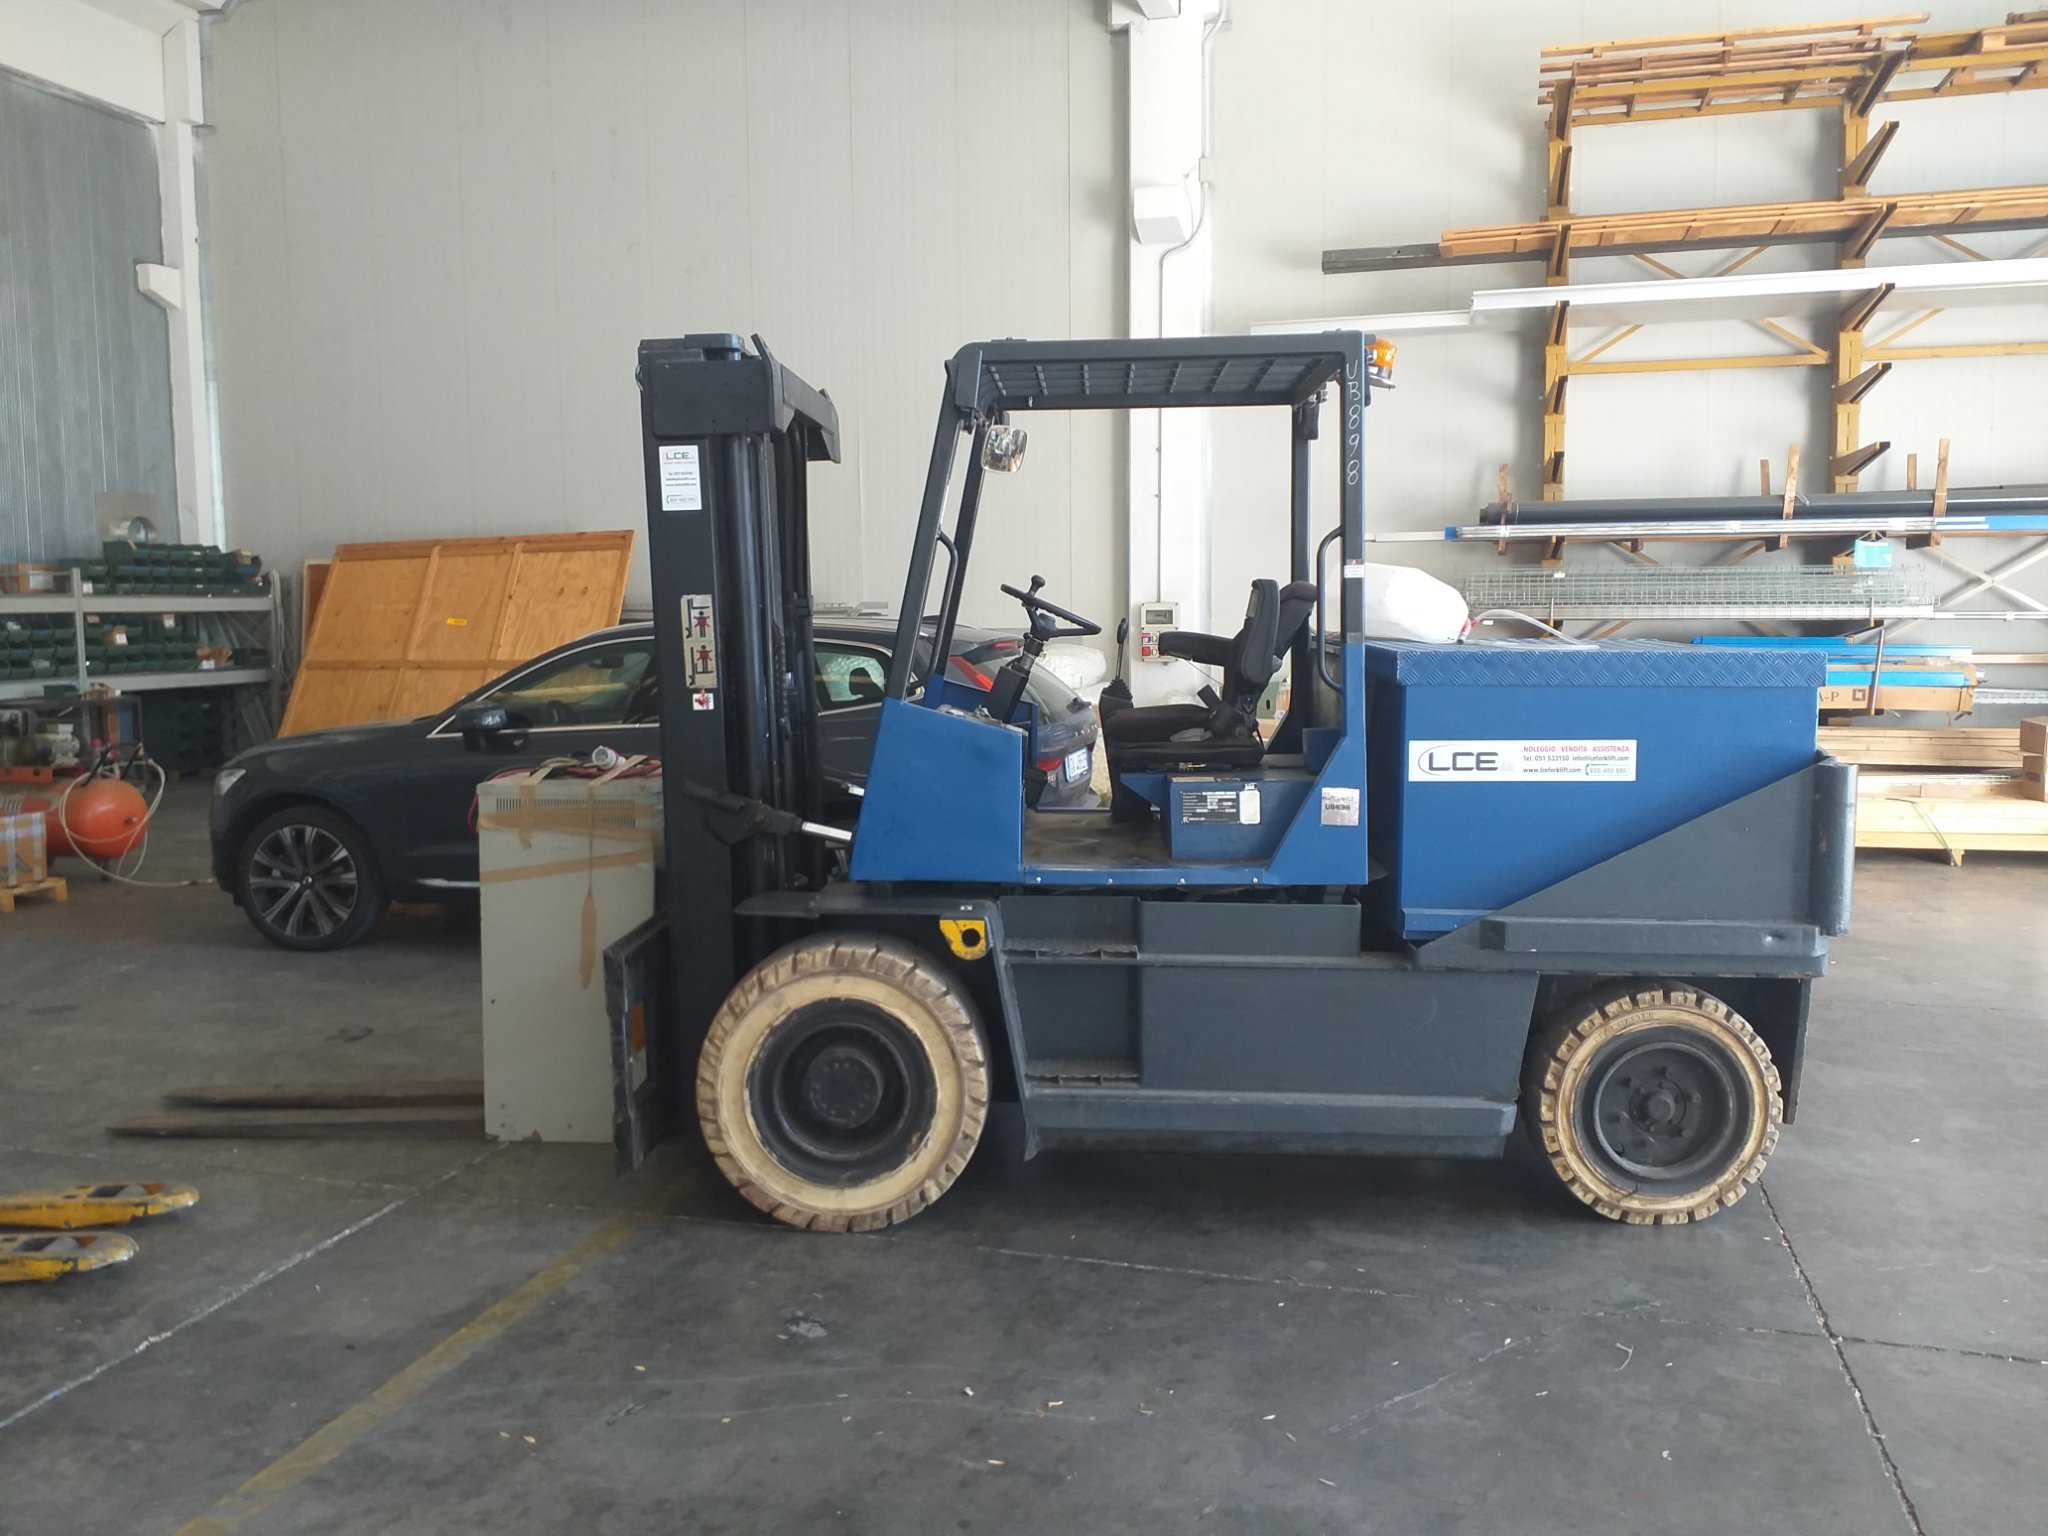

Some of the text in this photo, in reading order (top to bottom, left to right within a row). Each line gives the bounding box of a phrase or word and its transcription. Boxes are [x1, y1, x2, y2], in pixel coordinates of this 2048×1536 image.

[1346, 359, 1361, 485] UB898
[666, 452, 690, 460] LCE
[1429, 752, 1499, 771] LCE
